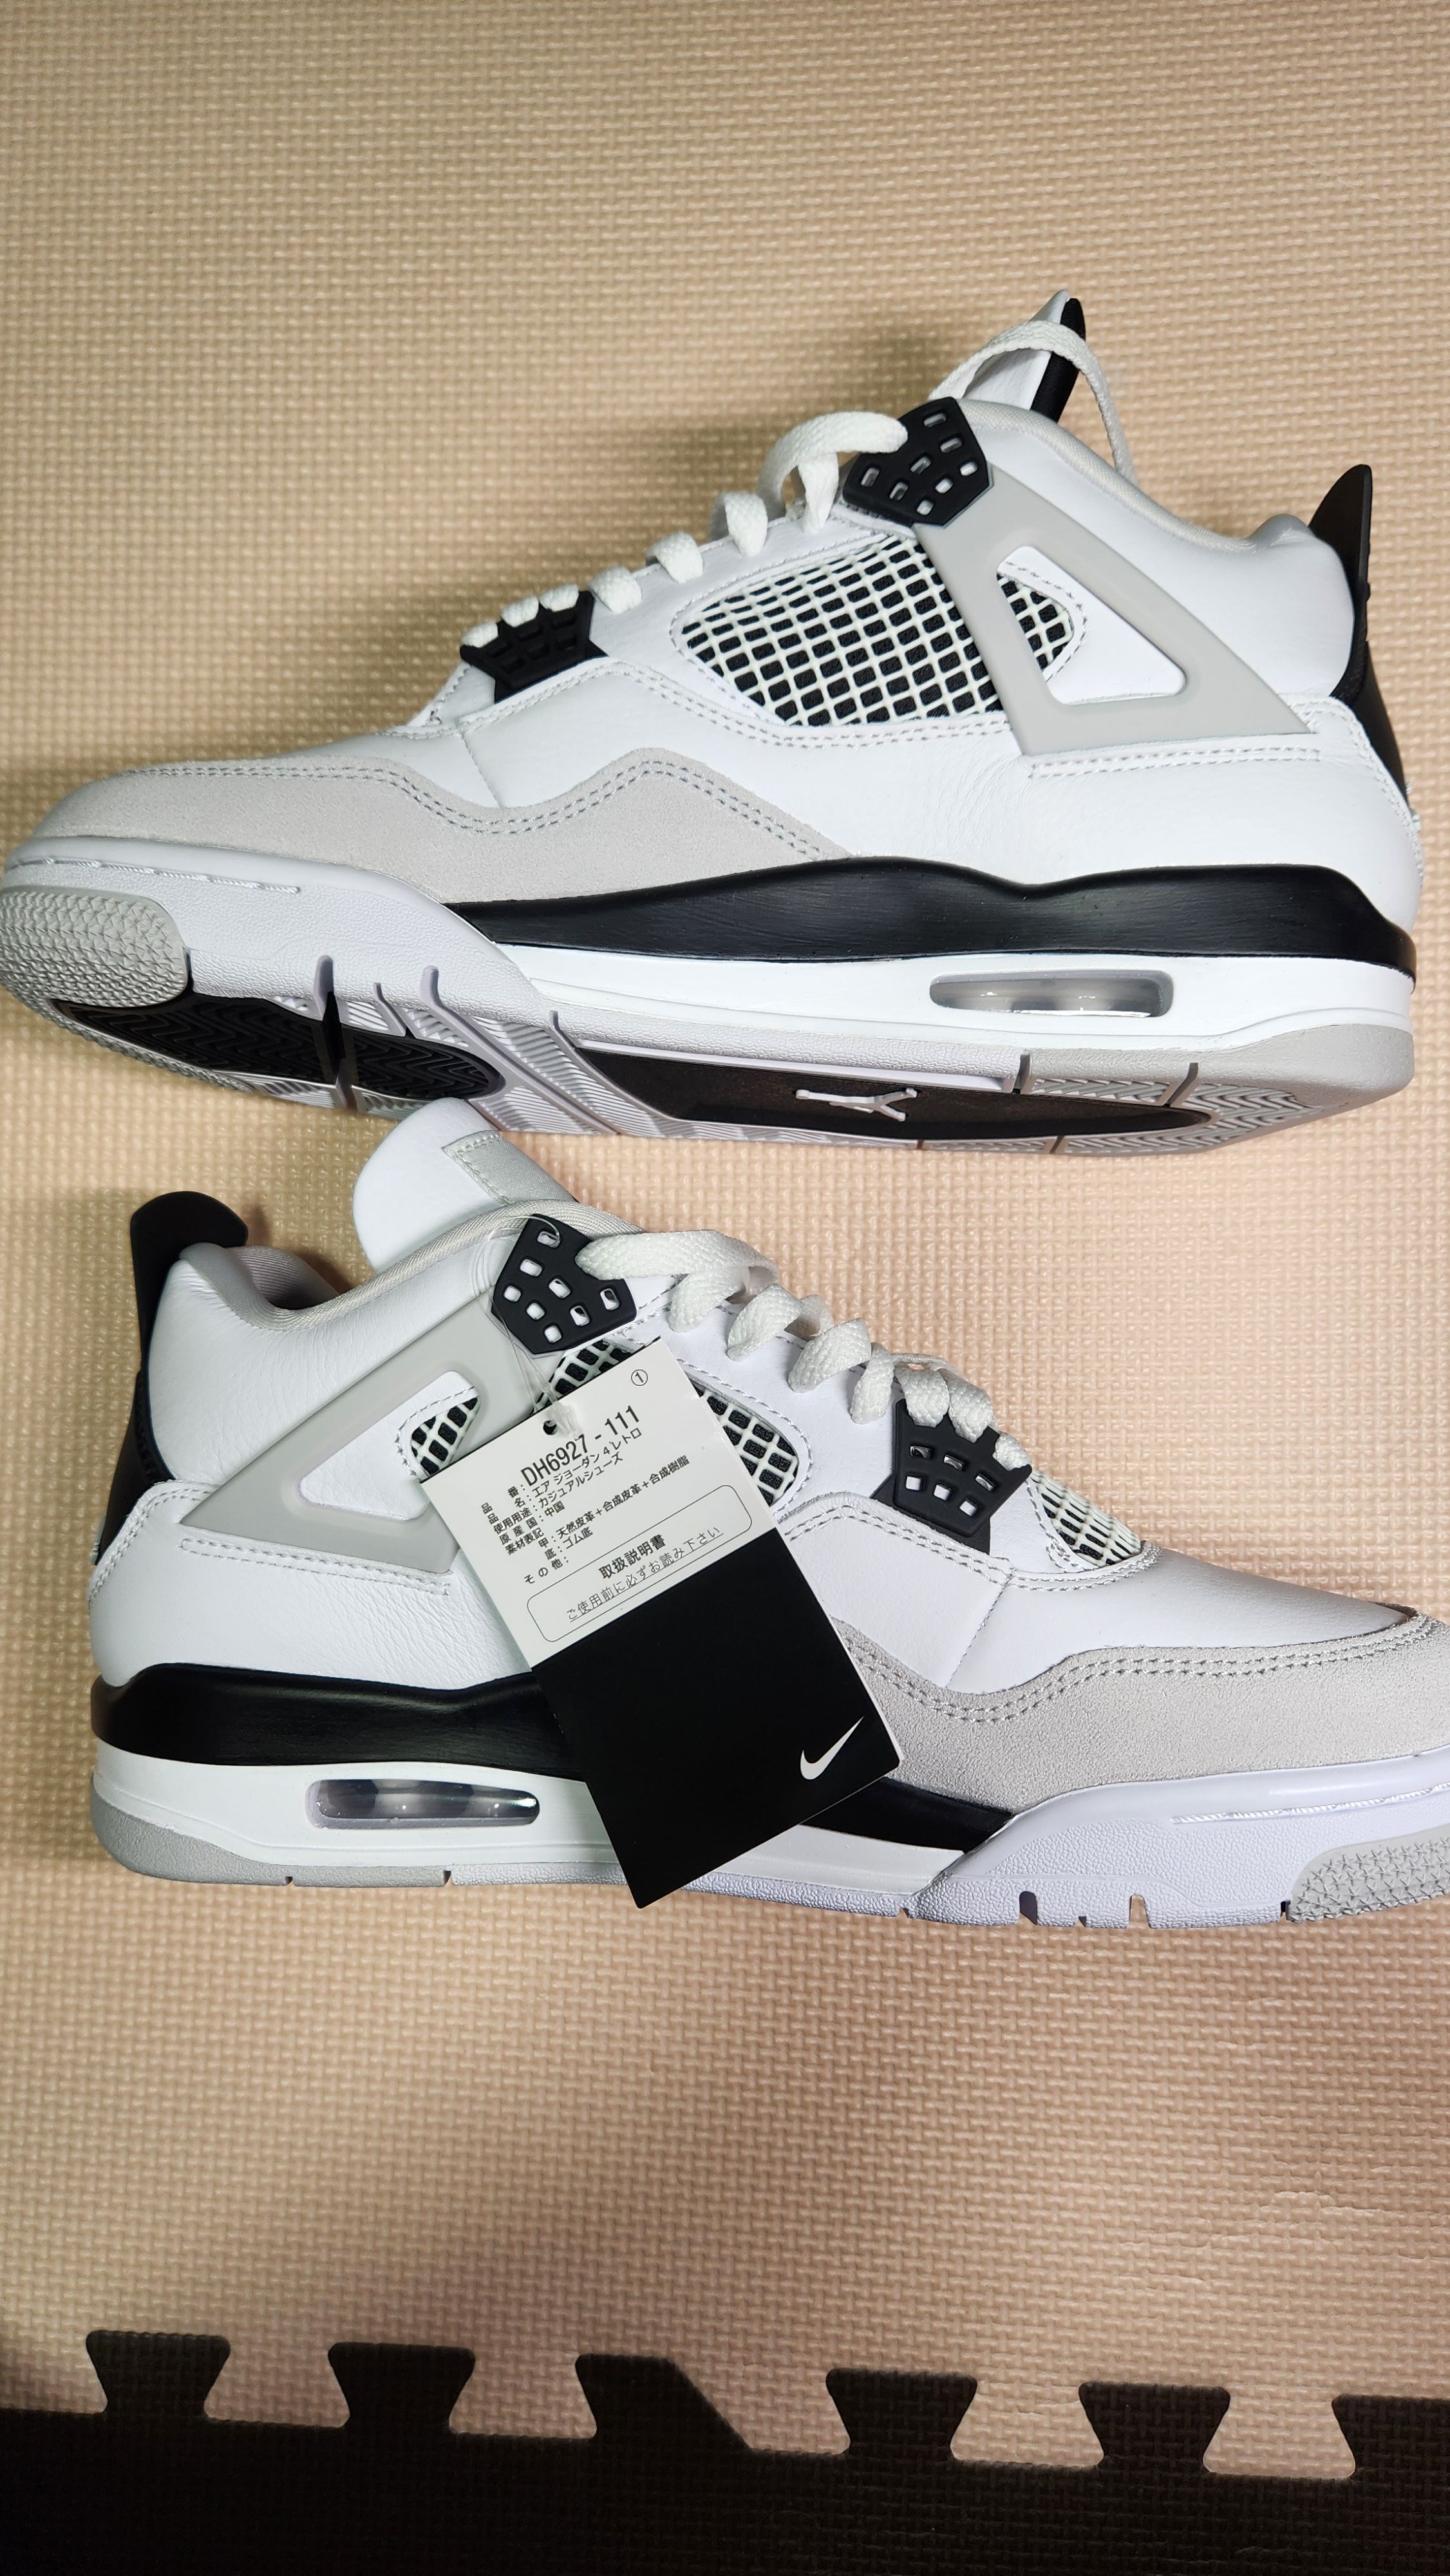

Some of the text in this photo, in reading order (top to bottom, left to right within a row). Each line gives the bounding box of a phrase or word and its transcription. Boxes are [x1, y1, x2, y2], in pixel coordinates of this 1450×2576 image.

[504, 1526, 545, 1556] 素材表記
[562, 1526, 594, 1549] ゴム底
[598, 1533, 666, 1579] 取扱説明書
[566, 1527, 722, 1622] ご使用前に必ずお読み下さい
